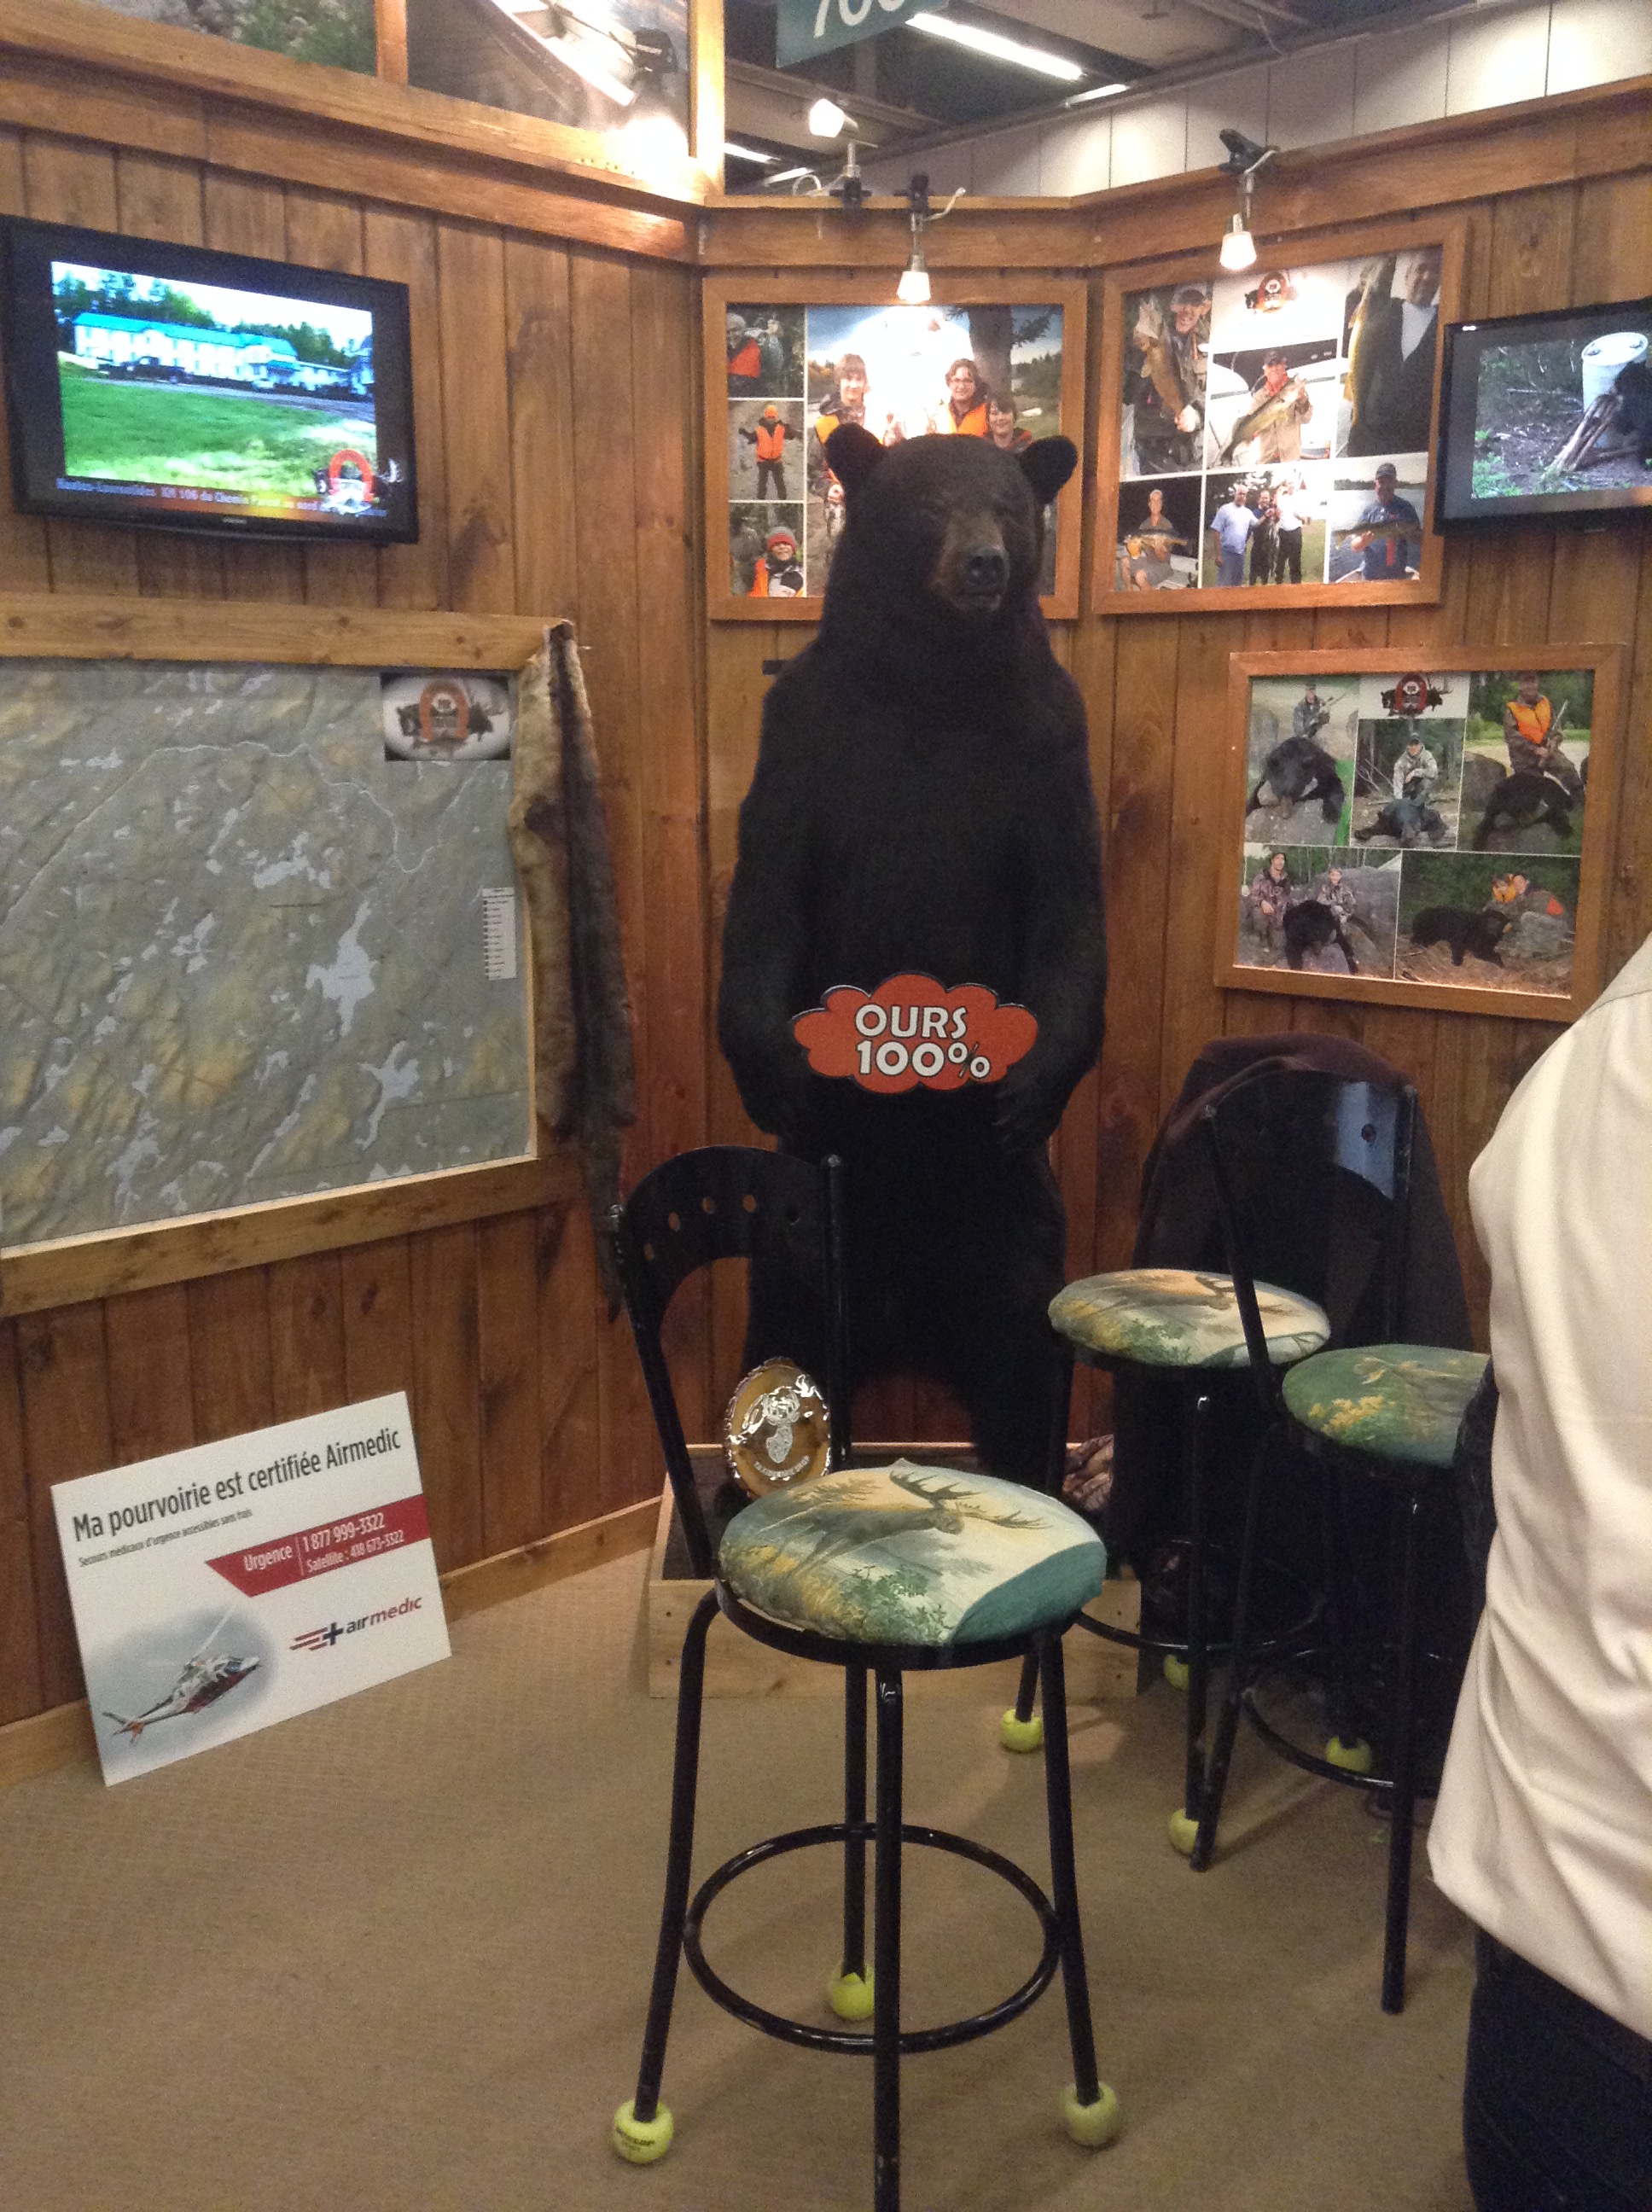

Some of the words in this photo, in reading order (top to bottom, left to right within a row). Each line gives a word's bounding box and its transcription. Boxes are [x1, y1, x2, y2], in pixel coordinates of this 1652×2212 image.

[855, 1004, 968, 1039] OURS
[856, 1039, 991, 1078] 100%
[73, 1512, 104, 1542] Ma
[108, 1482, 212, 1537] pourvoirie
[216, 1471, 244, 1500] est
[248, 1451, 322, 1492] certifiée
[326, 1428, 401, 1470] Airmedic
[243, 1545, 293, 1571] Urgence
[311, 1529, 331, 1550] 877
[333, 1512, 386, 1543] 999-3322
[346, 1597, 422, 1634] airmedic
